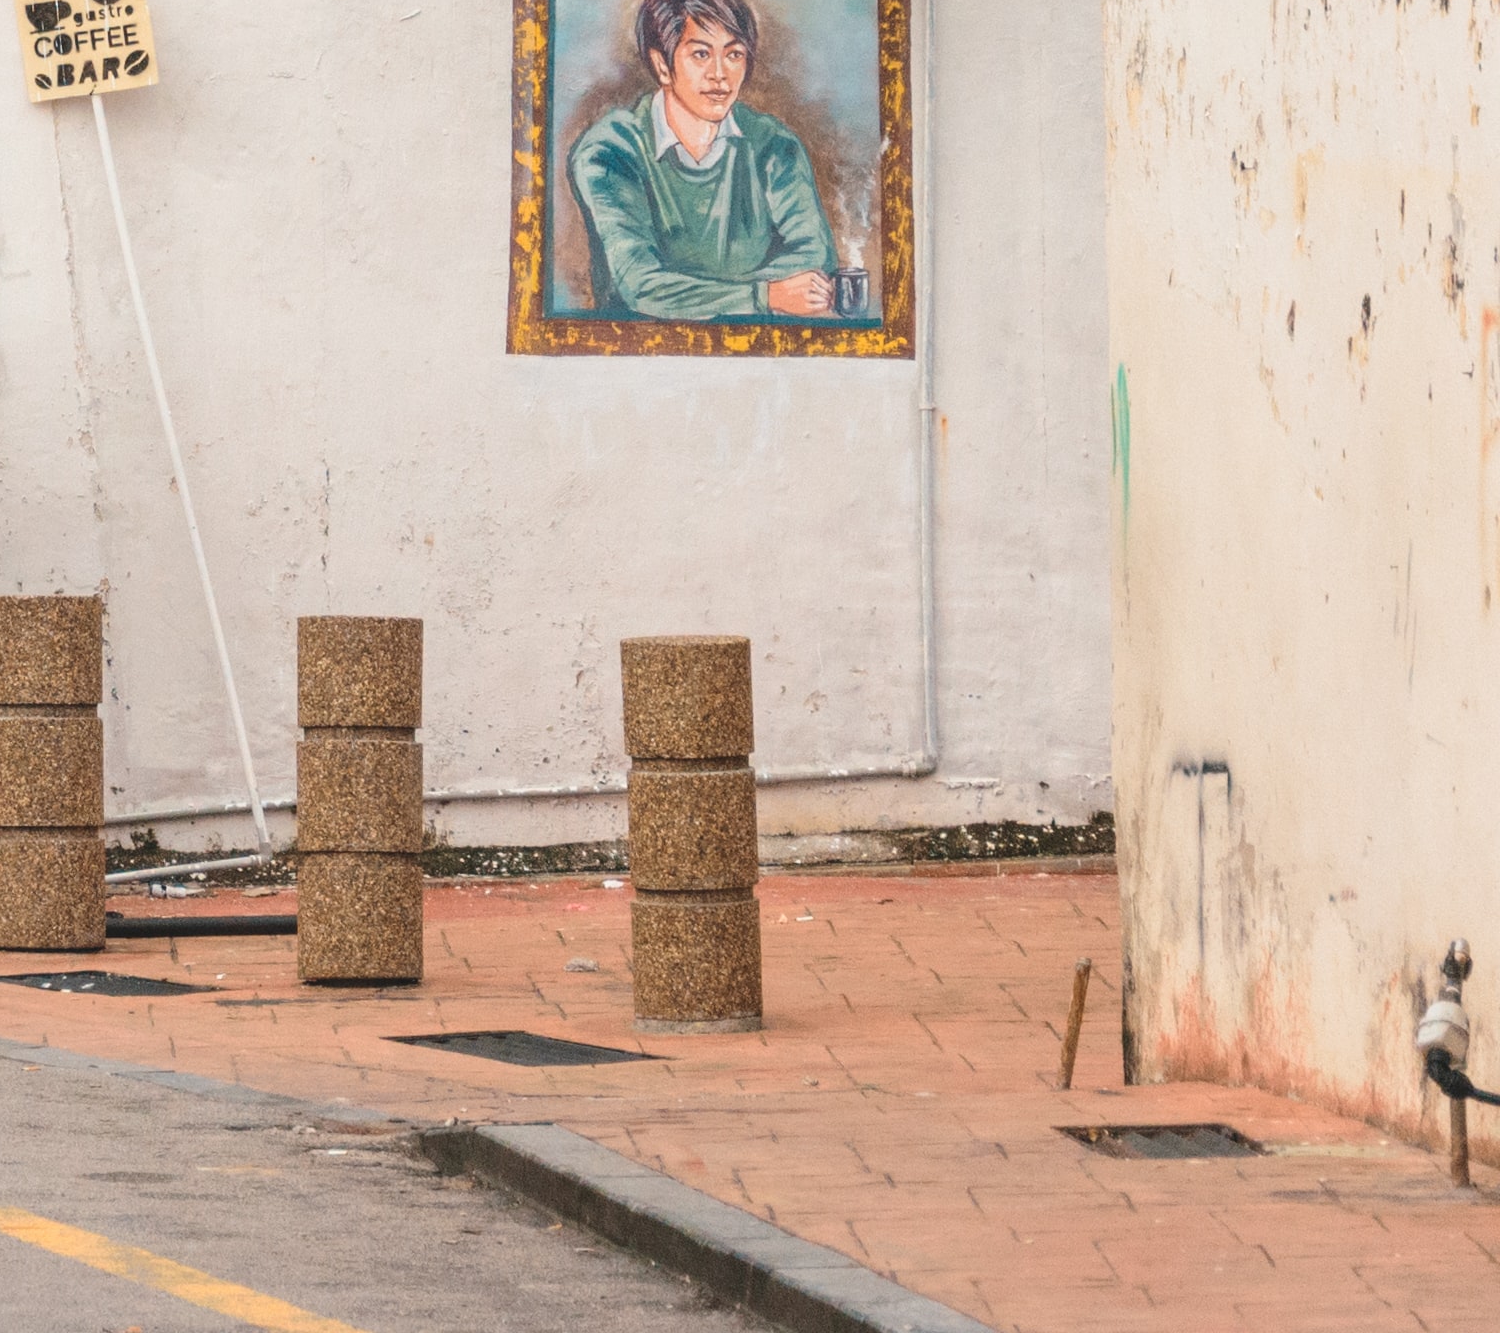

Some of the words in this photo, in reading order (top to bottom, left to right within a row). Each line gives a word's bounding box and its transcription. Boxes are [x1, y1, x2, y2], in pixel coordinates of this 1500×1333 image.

[73, 4, 134, 27] gastro
[33, 23, 141, 59] COFFEE
[56, 56, 122, 88] BAR
